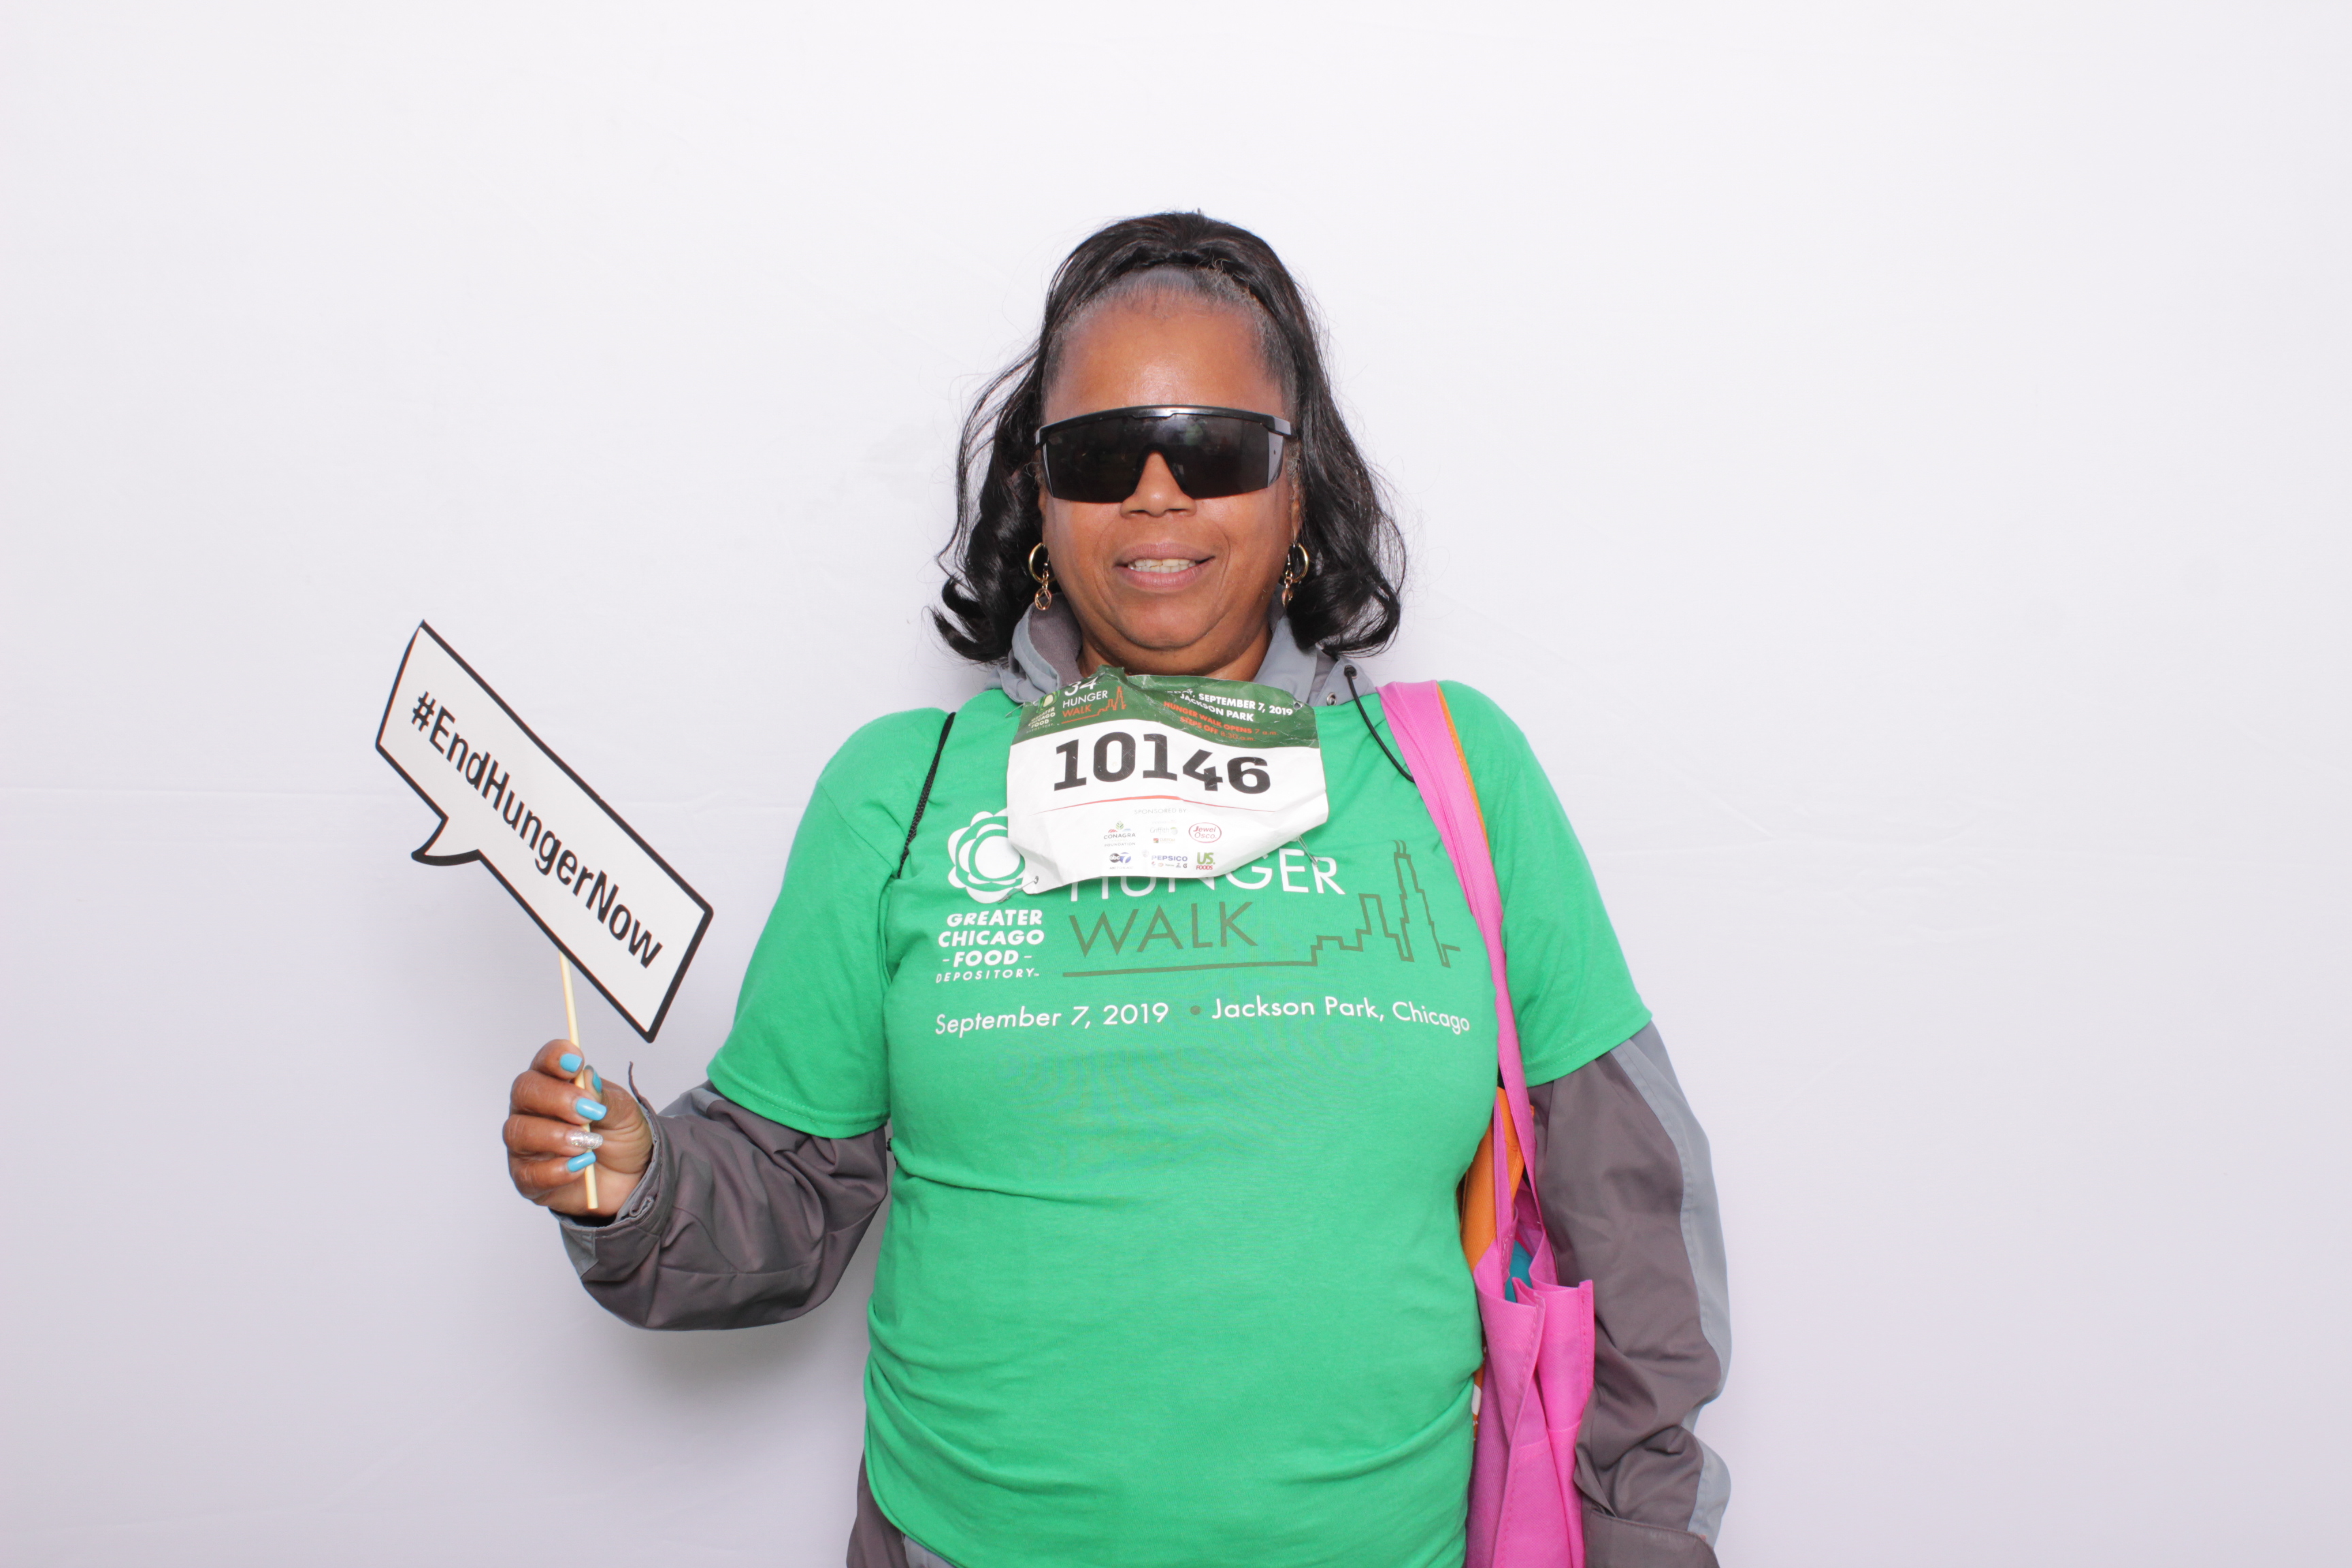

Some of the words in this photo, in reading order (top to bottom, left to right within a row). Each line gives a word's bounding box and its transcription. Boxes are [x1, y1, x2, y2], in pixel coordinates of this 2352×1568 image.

[1064, 676, 1098, 696] 34
[1062, 690, 1108, 708] HUNGER
[1180, 693, 1224, 716] JACKSON
[1226, 710, 1254, 721] PARK
[1198, 693, 1256, 710] SEPTEMBER
[1258, 702, 1266, 713] 7,
[1269, 705, 1293, 715] 2019
[1062, 704, 1092, 717] WALK
[1164, 701, 1198, 718] HUNGER
[1199, 714, 1222, 728] WALK
[1223, 723, 1252, 734] OPENS
[1031, 719, 1049, 729] FOOD
[1179, 716, 1202, 730] STEPS
[1203, 724, 1219, 734] OFF
[1054, 732, 1271, 794] 10146
[412, 691, 663, 968] #EndHungerNow
[947, 909, 1043, 927] GREATER
[938, 929, 1045, 947] CHICAGO
[1068, 901, 1258, 958] WALK
[953, 949, 1019, 968] FOOD
[935, 1006, 1062, 1039] September
[1071, 1006, 1091, 1029] 7,
[1103, 1002, 1169, 1024] 2019
[1211, 995, 1315, 1019] Jackson
[1325, 996, 1384, 1022] Park,
[1392, 1000, 1470, 1035] Chicago
